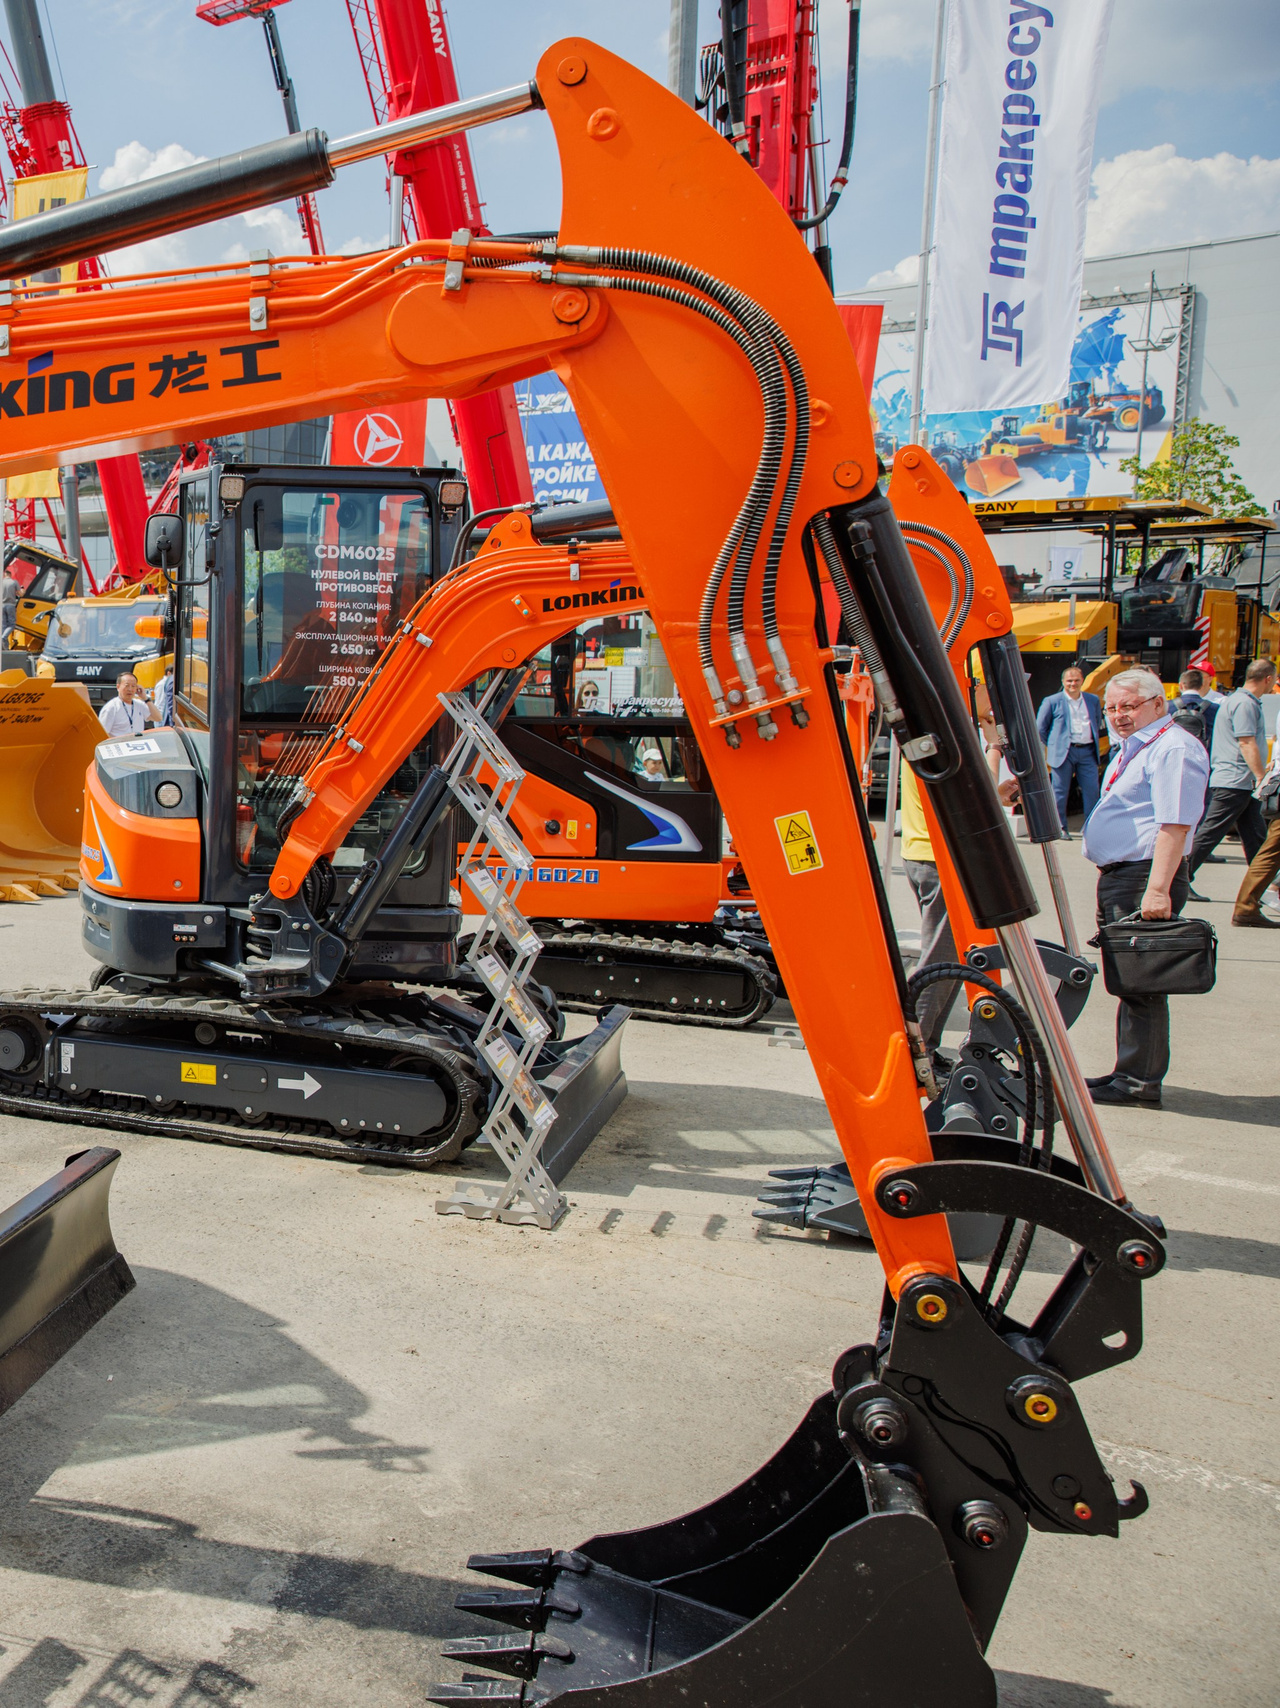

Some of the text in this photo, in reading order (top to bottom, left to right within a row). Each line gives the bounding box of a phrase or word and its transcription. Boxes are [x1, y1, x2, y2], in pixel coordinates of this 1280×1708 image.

[148, 340, 282, 398] 龙工
[974, 502, 1018, 513] SANY
[314, 544, 395, 561] CDM6025
[311, 569, 398, 582] НУЛЕВОЙ ВЫЛЕТ
[315, 582, 394, 594] ПРОТИВОВЕСА
[316, 601, 392, 611] ГЛУБИНА КОПАНИЯ:
[329, 612, 337, 622] 2
[339, 612, 363, 623] 840
[295, 632, 379, 642] ЭКСПЛУАТАЦИОННАЯ
[330, 644, 338, 654] 2
[340, 644, 364, 655] 650
[76, 666, 102, 676] SANY
[319, 665, 383, 675] ШИРИНА КОВА
[332, 675, 356, 686] 580
[487, 866, 599, 884] DM6020
